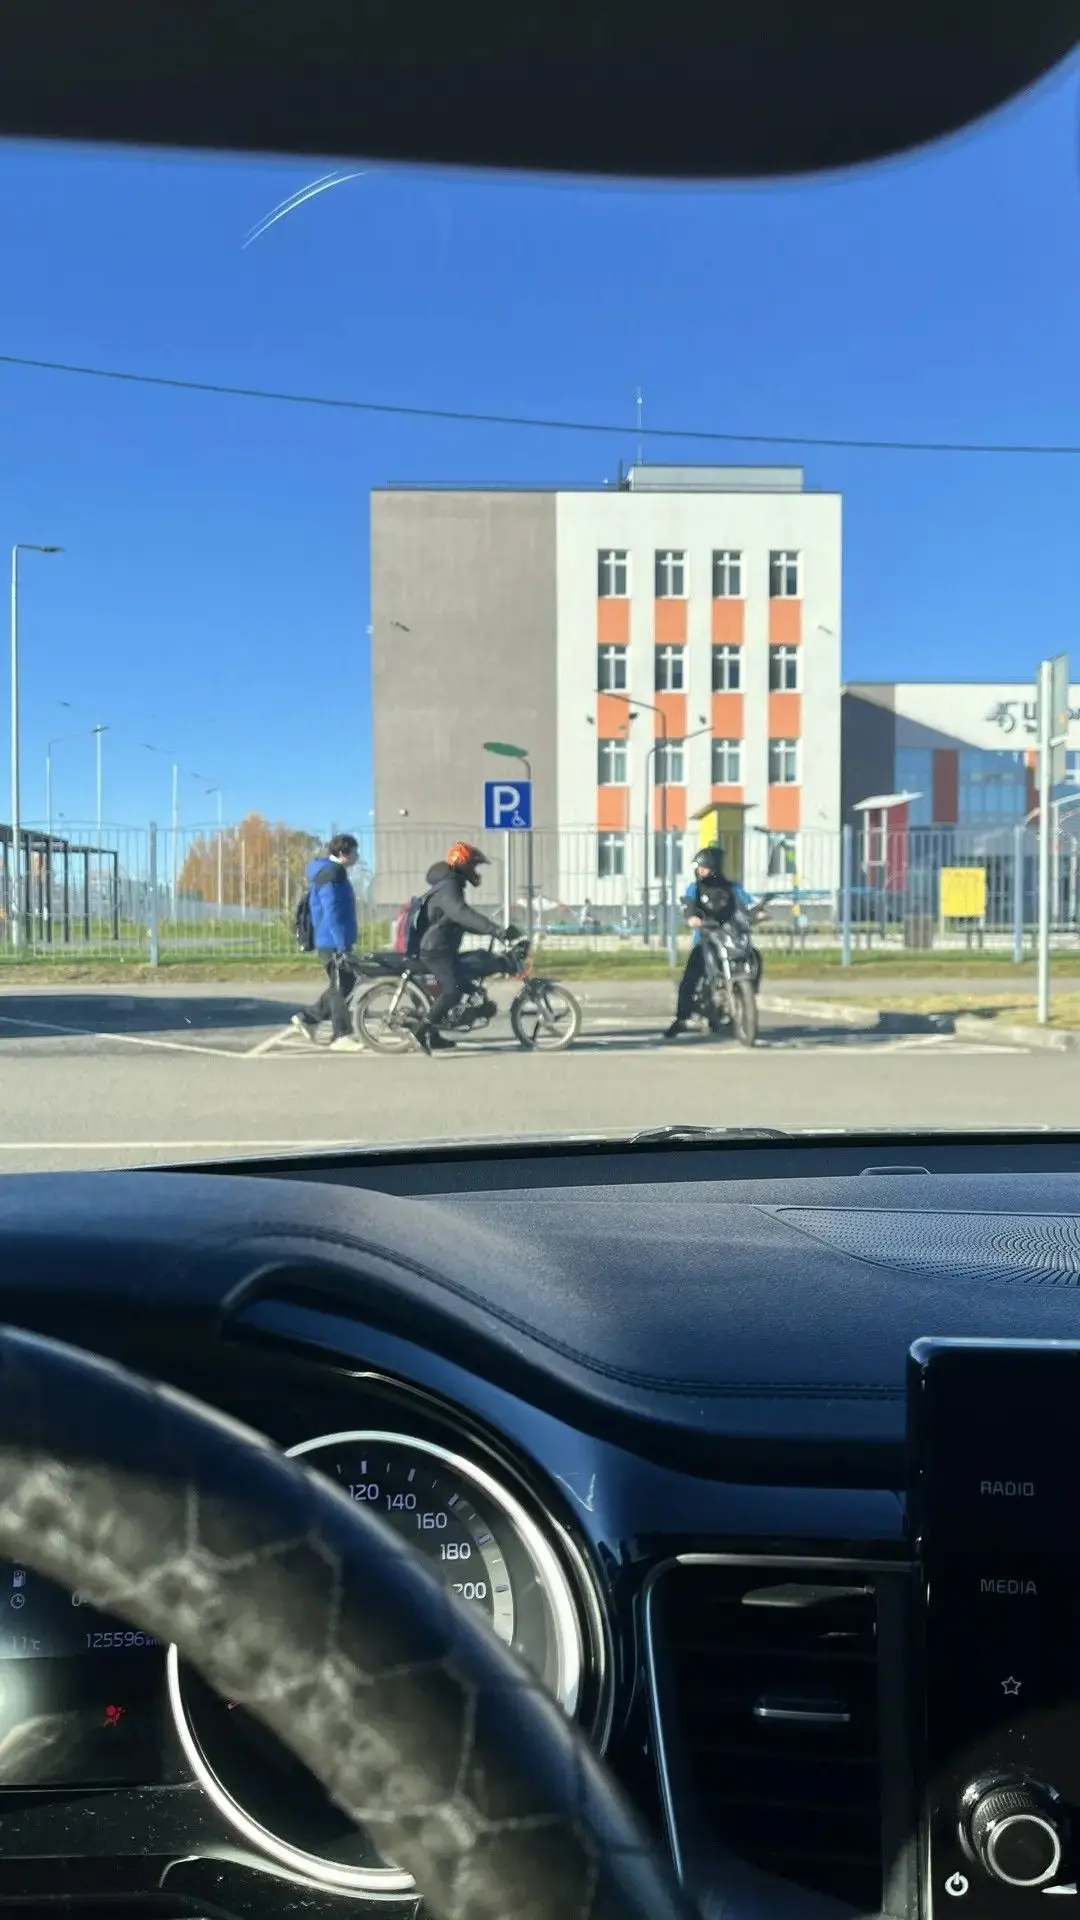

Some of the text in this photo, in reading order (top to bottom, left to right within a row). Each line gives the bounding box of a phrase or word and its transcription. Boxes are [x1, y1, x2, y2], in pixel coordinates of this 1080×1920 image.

[493, 785, 521, 826] P
[348, 1483, 380, 1501] 120
[980, 1480, 1035, 1497] RADIO
[386, 1493, 417, 1510] 140
[416, 1512, 448, 1530] 160
[440, 1542, 472, 1560] 180
[980, 1578, 1038, 1595] MEDIA
